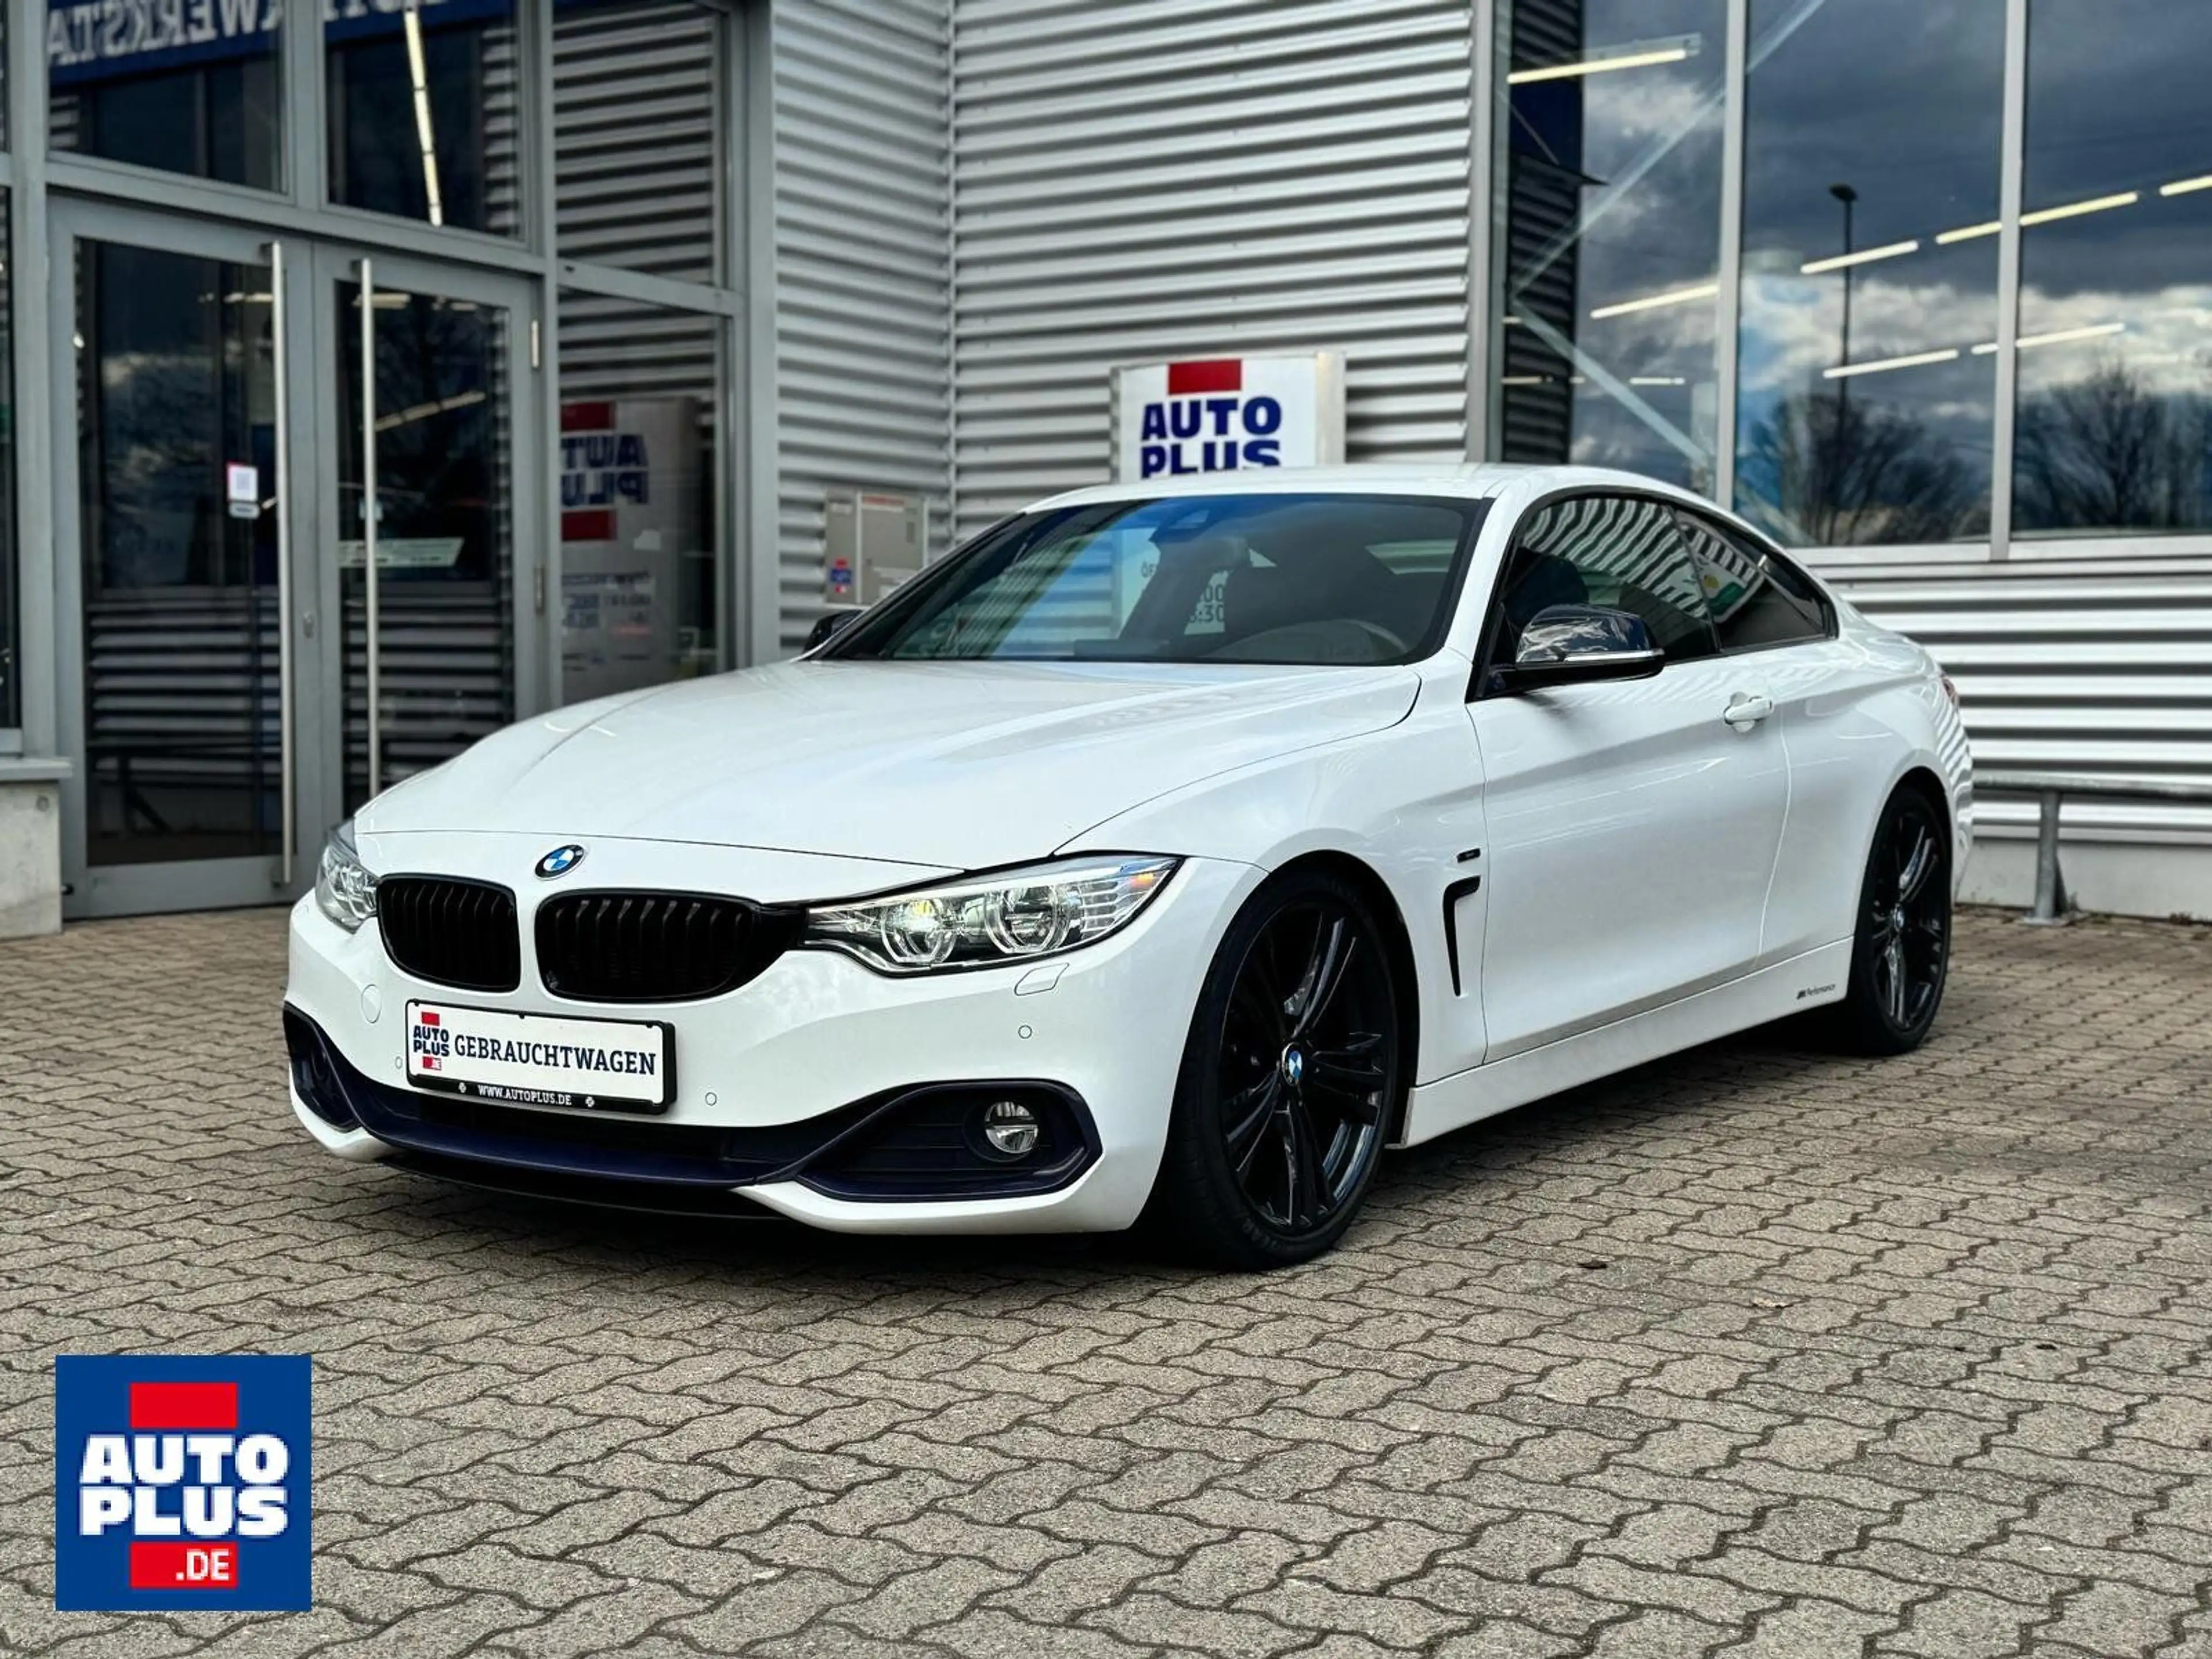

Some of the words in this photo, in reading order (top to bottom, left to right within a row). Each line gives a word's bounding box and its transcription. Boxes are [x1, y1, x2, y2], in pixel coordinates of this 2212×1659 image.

[1141, 396, 1282, 441] AUTO
[1141, 440, 1280, 480] PLUS
[413, 1025, 449, 1043] AUTO
[413, 1039, 450, 1057] PLUS
[454, 1035, 657, 1075] GEBRAUCHTWAGEN
[478, 1084, 572, 1107] WWW.AUTOPLUS.DE
